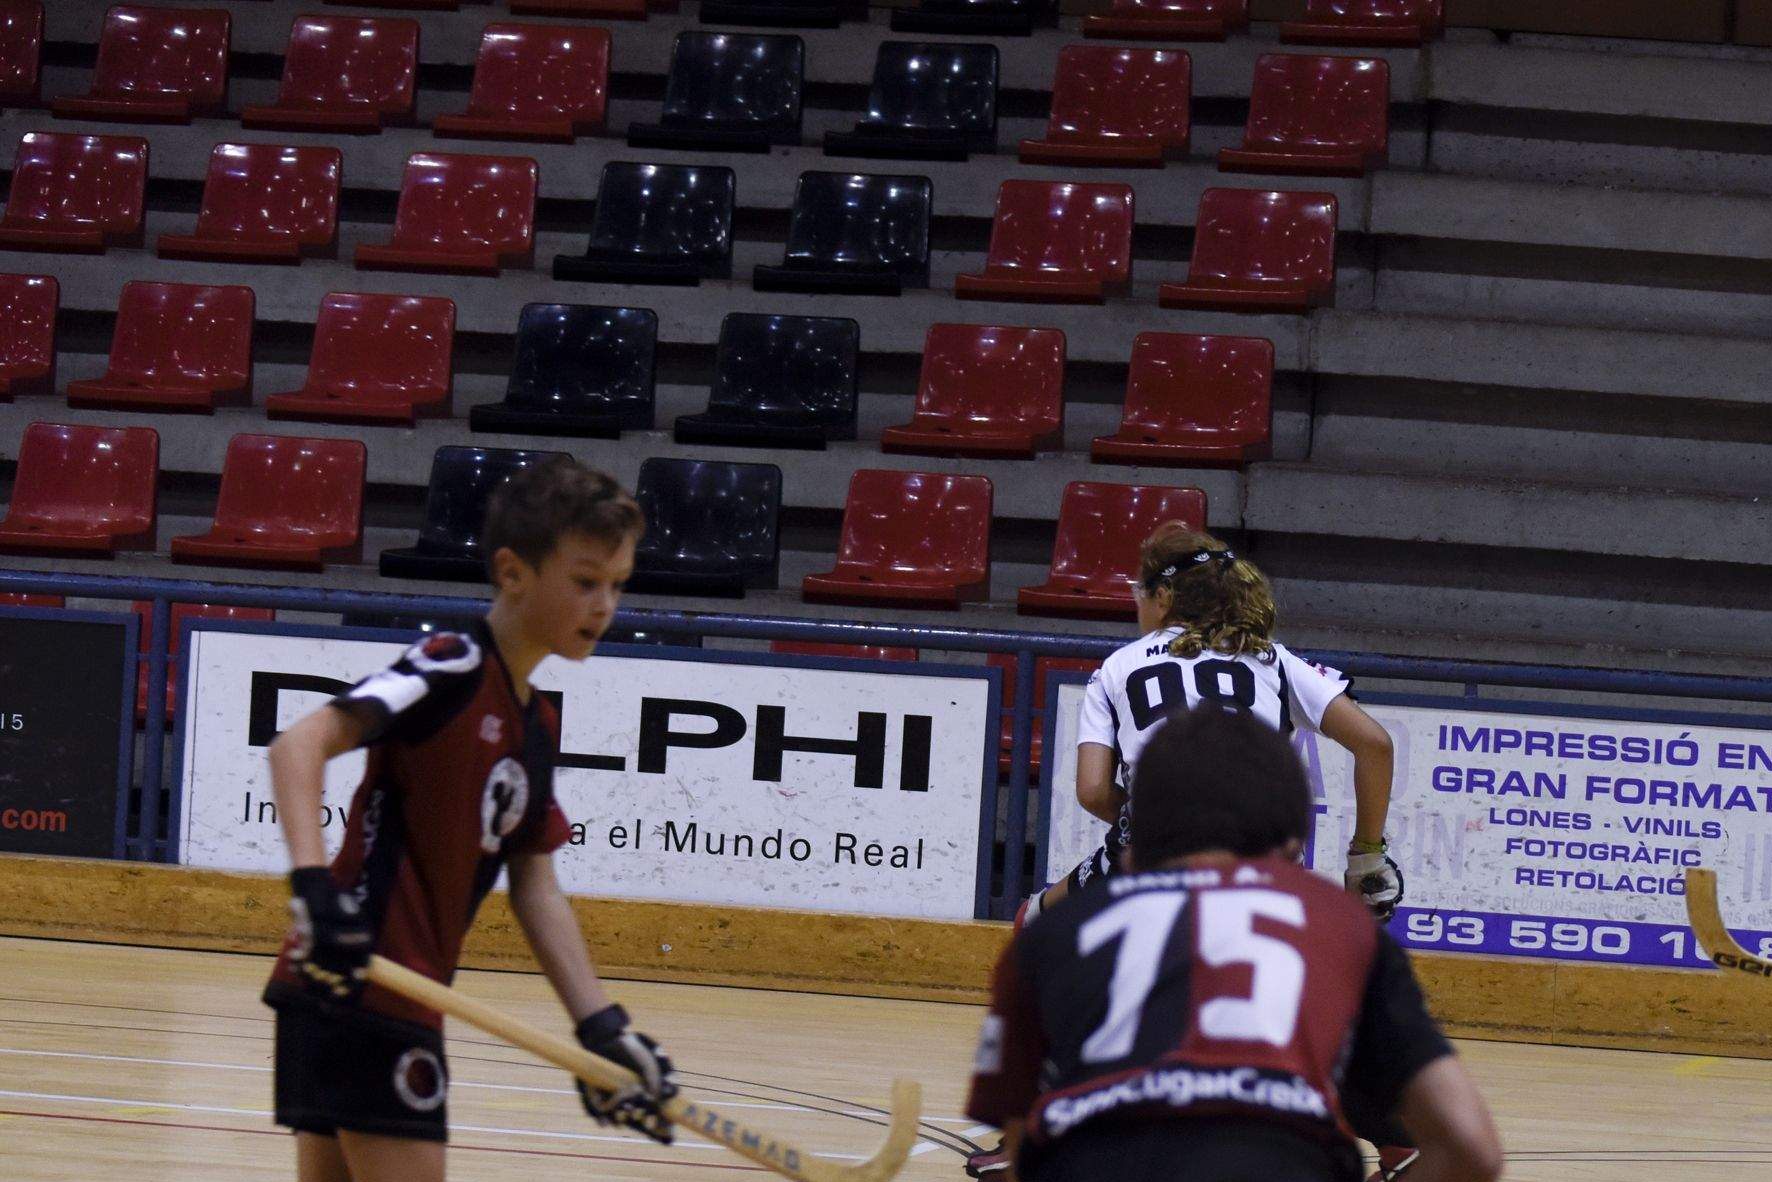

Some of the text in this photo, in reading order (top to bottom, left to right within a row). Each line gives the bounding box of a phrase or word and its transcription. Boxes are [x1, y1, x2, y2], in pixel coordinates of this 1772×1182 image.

[248, 670, 933, 793] DLPHI
[1437, 724, 1700, 767] IMPRESSIÓ
[1432, 766, 1567, 799] GRAN
[608, 818, 641, 849] el
[664, 820, 811, 862] Mundo
[834, 832, 923, 870] Real
[1489, 807, 1593, 831] LONES
[1622, 816, 1721, 839] VINILS
[1505, 838, 1702, 867] FOTOGRÀFIC
[1514, 868, 1687, 896] RETOLACIÓ
[1406, 913, 1485, 946] 93
[1509, 920, 1631, 956] 590
[1078, 889, 1307, 1064] 75
